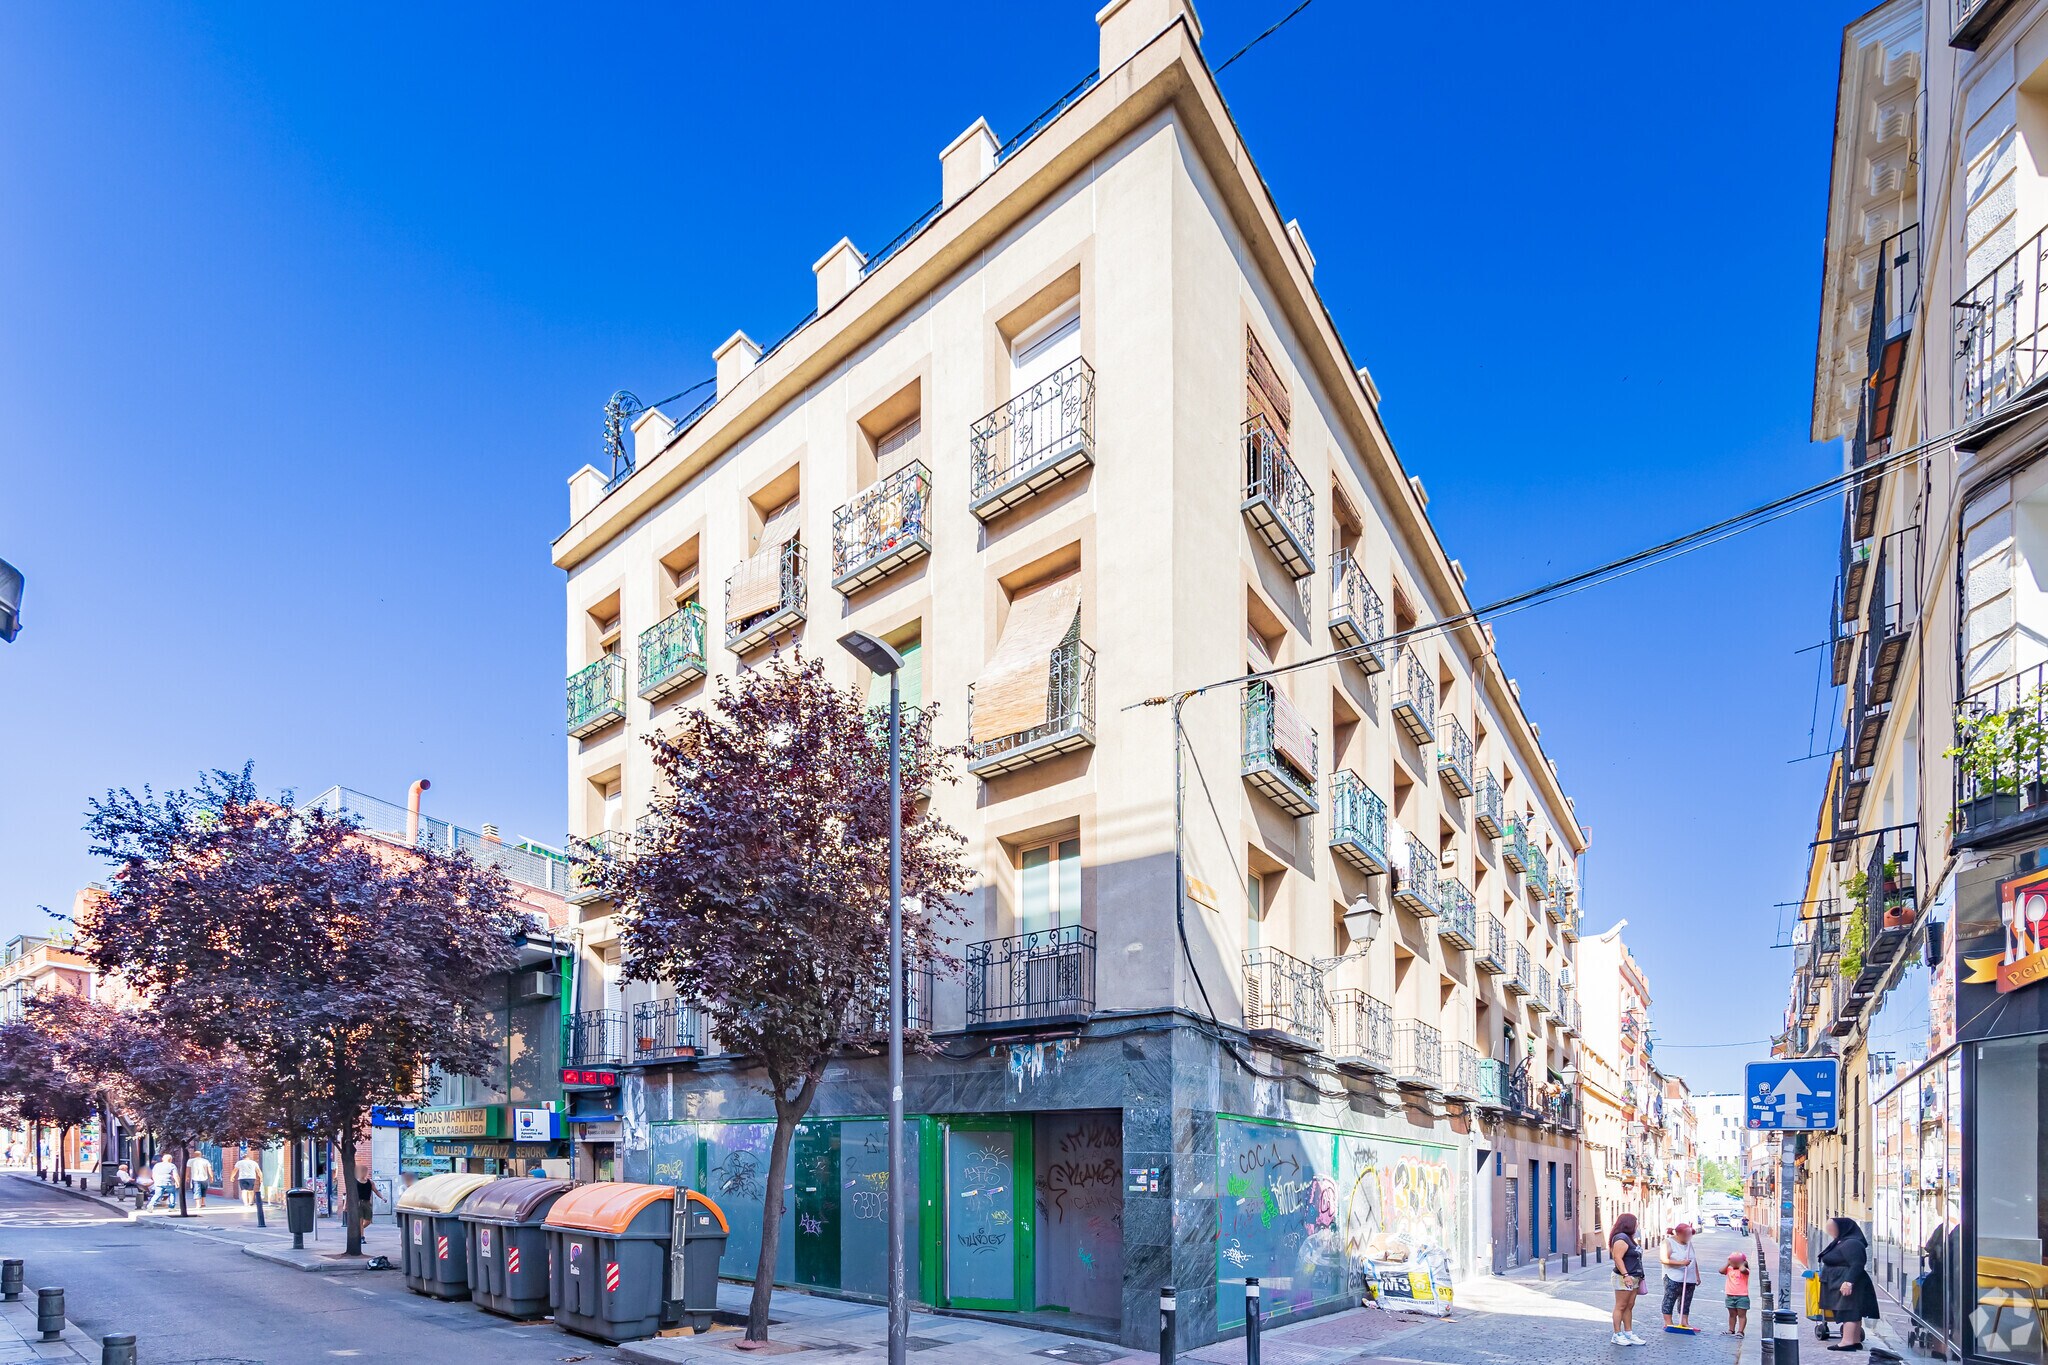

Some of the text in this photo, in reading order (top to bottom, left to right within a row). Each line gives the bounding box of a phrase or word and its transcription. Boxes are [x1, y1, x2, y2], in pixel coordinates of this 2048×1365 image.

[417, 1111, 443, 1124] MODAS
[444, 1109, 484, 1123] MARTINEZ
[441, 1125, 446, 1135] Y
[446, 1124, 484, 1135] CABALLERO
[432, 1145, 467, 1156] CABALLERO
